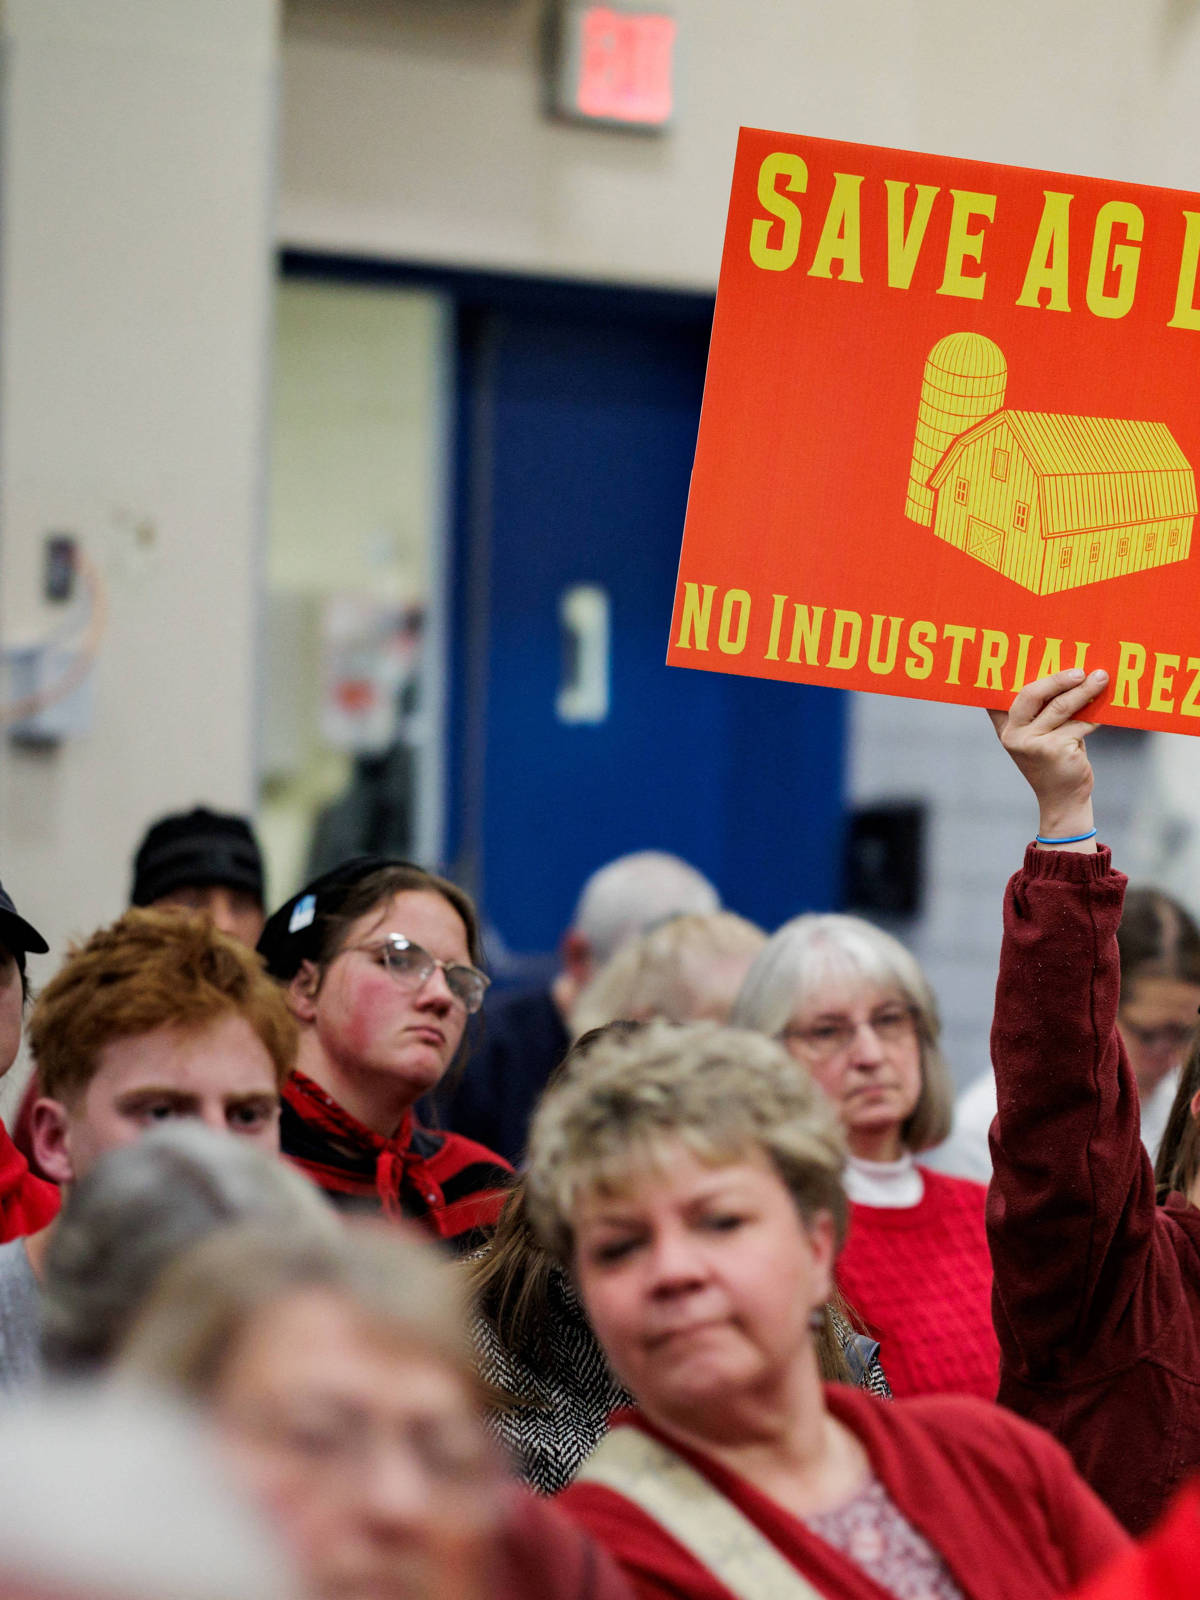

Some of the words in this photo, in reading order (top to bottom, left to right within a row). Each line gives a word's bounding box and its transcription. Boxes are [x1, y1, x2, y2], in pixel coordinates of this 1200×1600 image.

[748, 151, 998, 301] SAVE
[1015, 190, 1146, 320] AG
[674, 581, 752, 656] NO
